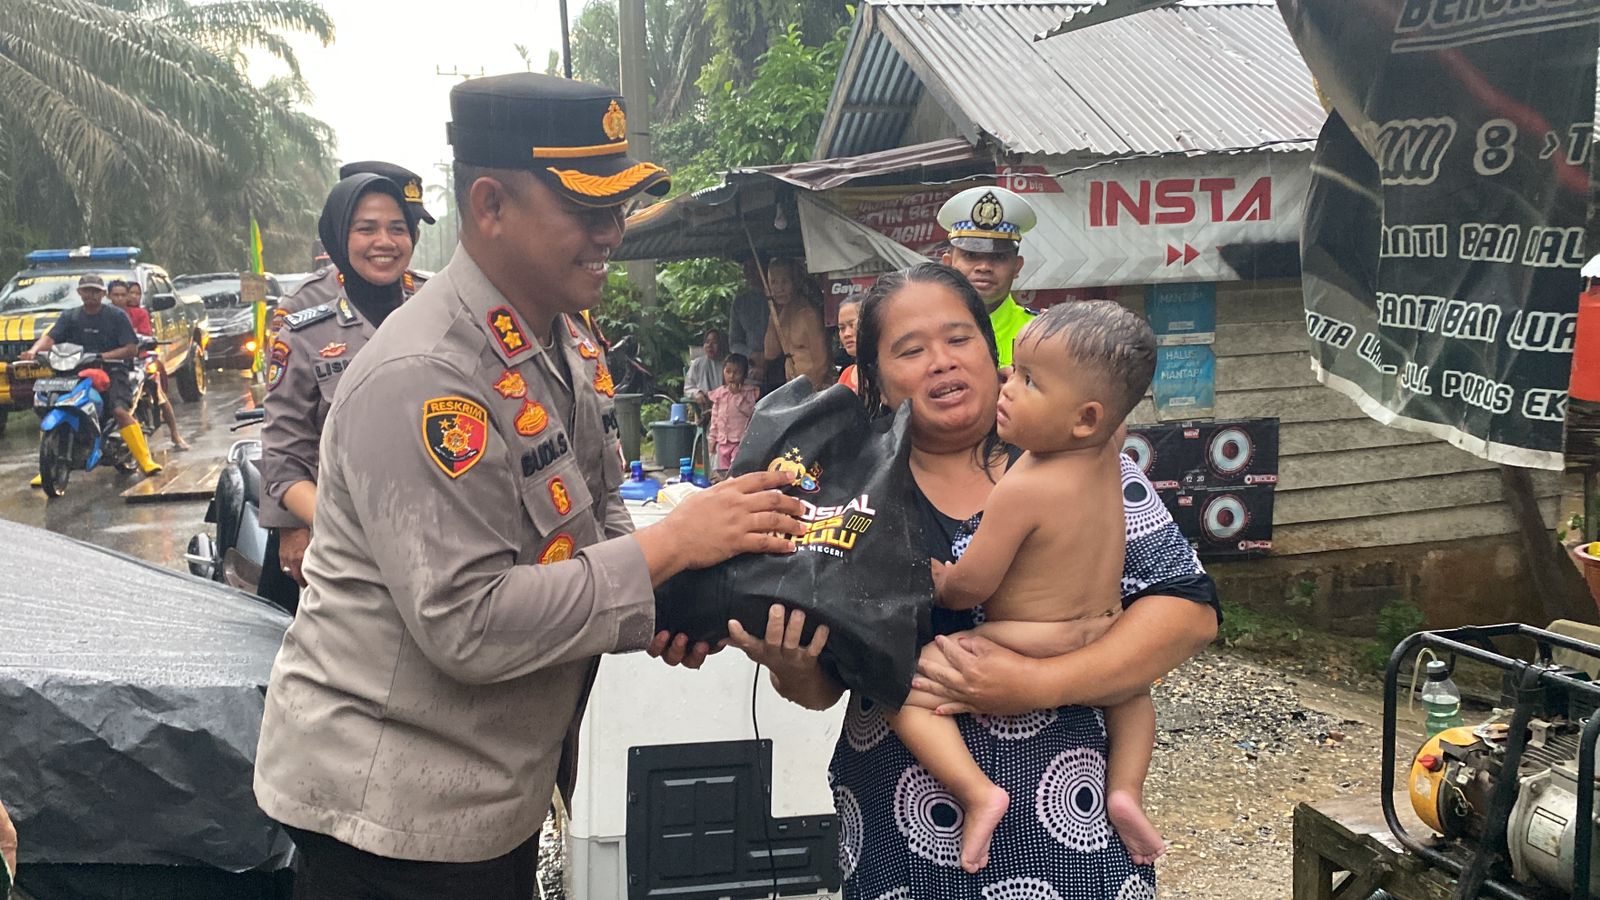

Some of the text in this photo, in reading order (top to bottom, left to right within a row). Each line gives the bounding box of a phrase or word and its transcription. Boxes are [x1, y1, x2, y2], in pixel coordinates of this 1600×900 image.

[1089, 176, 1272, 227] INSTA
[1459, 223, 1521, 262] BAN
[1376, 292, 1443, 333] ANTI
[1442, 300, 1503, 343] BAN
[430, 401, 484, 420] RESKRIM
[1442, 370, 1514, 414] POROS
[809, 544, 844, 558] NEGERI
